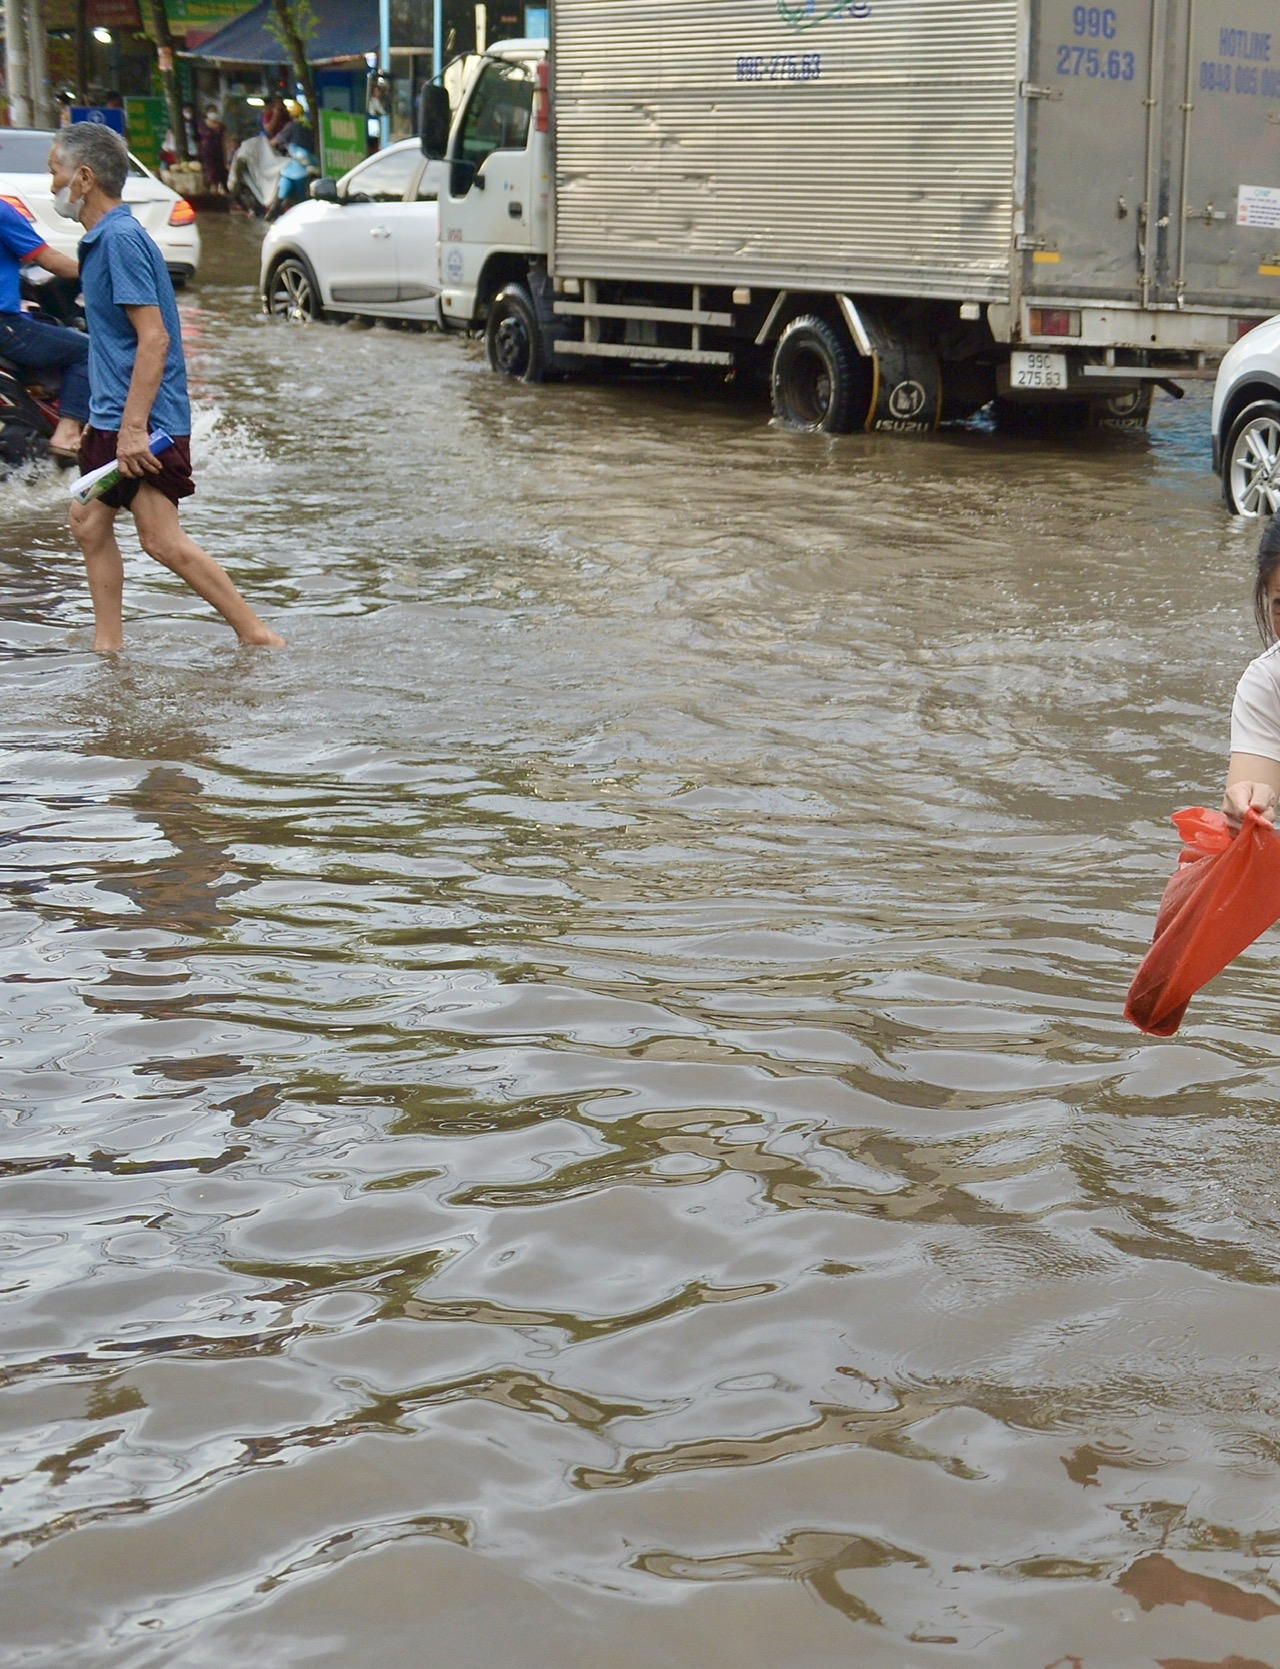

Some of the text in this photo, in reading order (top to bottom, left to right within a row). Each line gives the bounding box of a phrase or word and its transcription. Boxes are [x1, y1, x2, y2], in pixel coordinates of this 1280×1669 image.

[1073, 6, 1117, 39] 99C
[1219, 27, 1271, 62] HOTLINE
[1056, 45, 1135, 81] 275.63
[1028, 354, 1052, 369] 99C
[1018, 370, 1062, 387] 275.63
[875, 419, 930, 432] ISUZU
